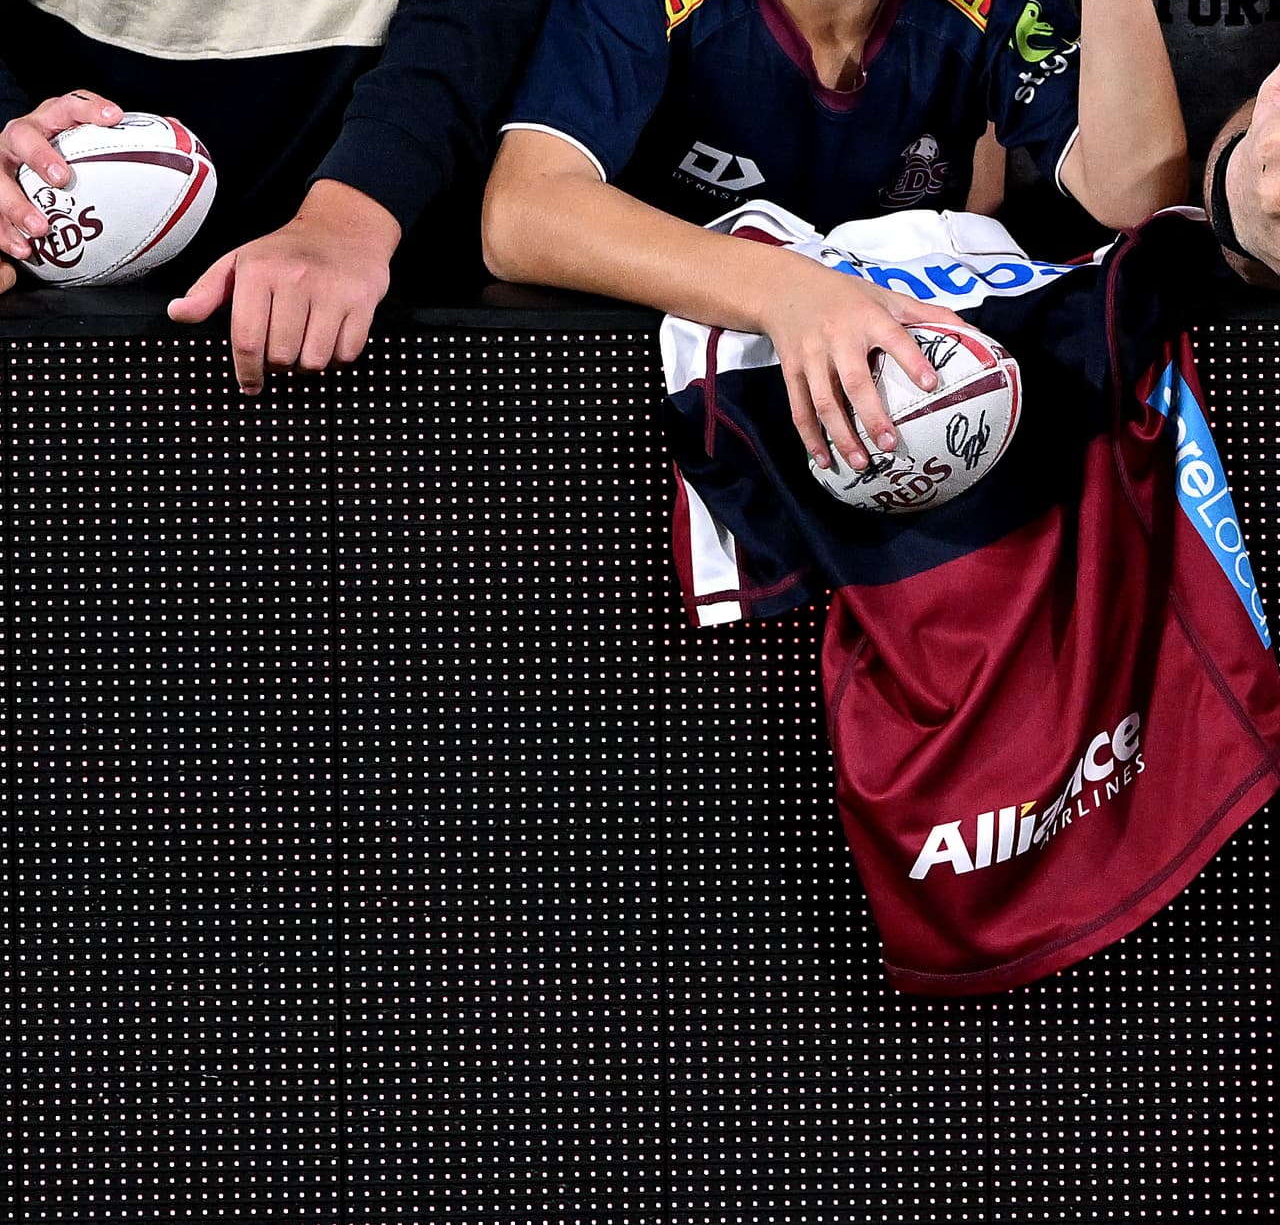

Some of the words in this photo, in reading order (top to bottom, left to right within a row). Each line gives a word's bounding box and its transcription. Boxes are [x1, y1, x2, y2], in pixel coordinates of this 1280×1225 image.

[672, 172, 751, 204] DYNAST
[28, 205, 104, 269] REDS
[871, 456, 952, 512] REDS
[908, 712, 1140, 880] Alliance
[1030, 754, 1146, 850] AIRLINES
